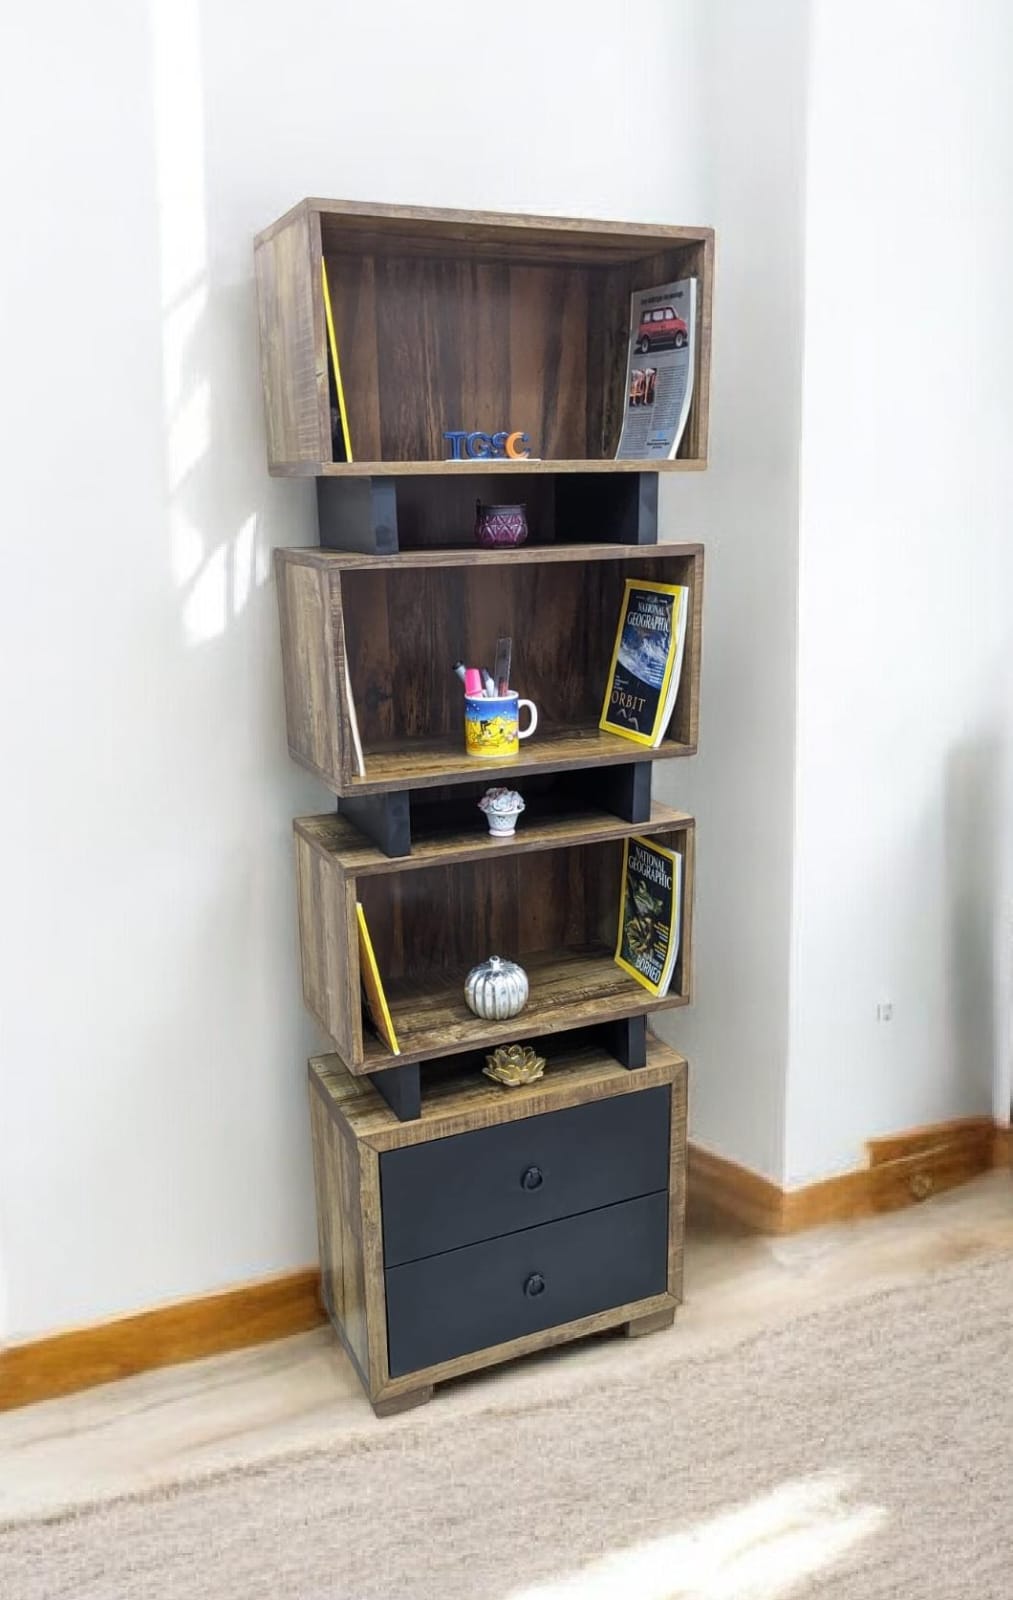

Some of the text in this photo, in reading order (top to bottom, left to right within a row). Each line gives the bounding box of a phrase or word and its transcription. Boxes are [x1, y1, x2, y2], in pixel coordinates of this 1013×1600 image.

[638, 601, 665, 616] NATIONAL
[611, 690, 646, 712] ORBIT
[635, 846, 665, 872] NATIONAL
[628, 855, 672, 890] GEOGRAPHIC
[635, 955, 661, 983] BORNEO
